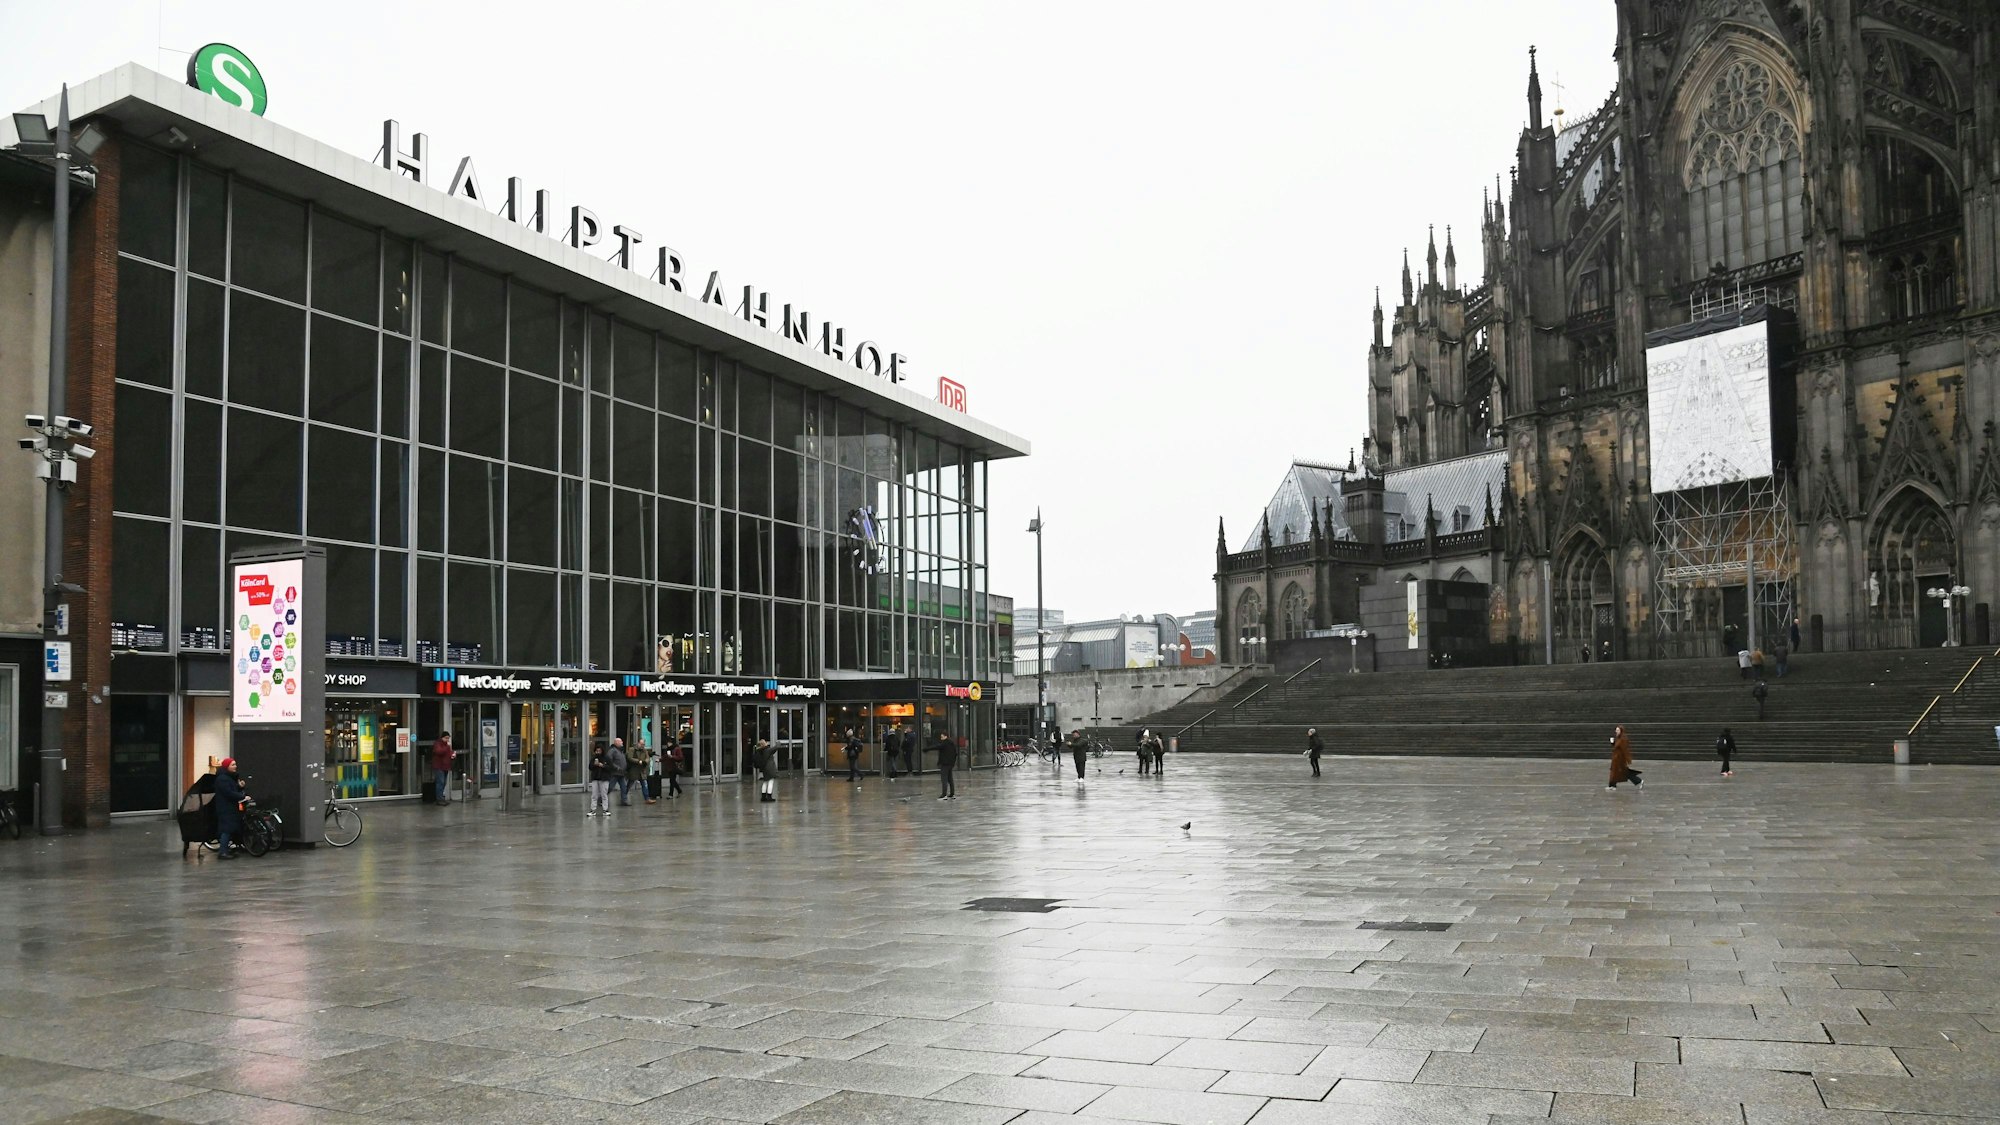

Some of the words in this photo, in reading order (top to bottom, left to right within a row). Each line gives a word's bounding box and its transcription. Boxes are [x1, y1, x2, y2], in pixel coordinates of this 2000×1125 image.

[211, 53, 254, 113] S
[382, 119, 908, 389] HAUPTBAHNHOF
[944, 383, 964, 413] DB
[338, 674, 367, 686] SHOP
[457, 675, 532, 693] NetCologne
[562, 677, 616, 694] Highspeed
[640, 680, 696, 696] NetCologne
[719, 682, 760, 697] Highspeed
[777, 685, 820, 697] NetCologne
